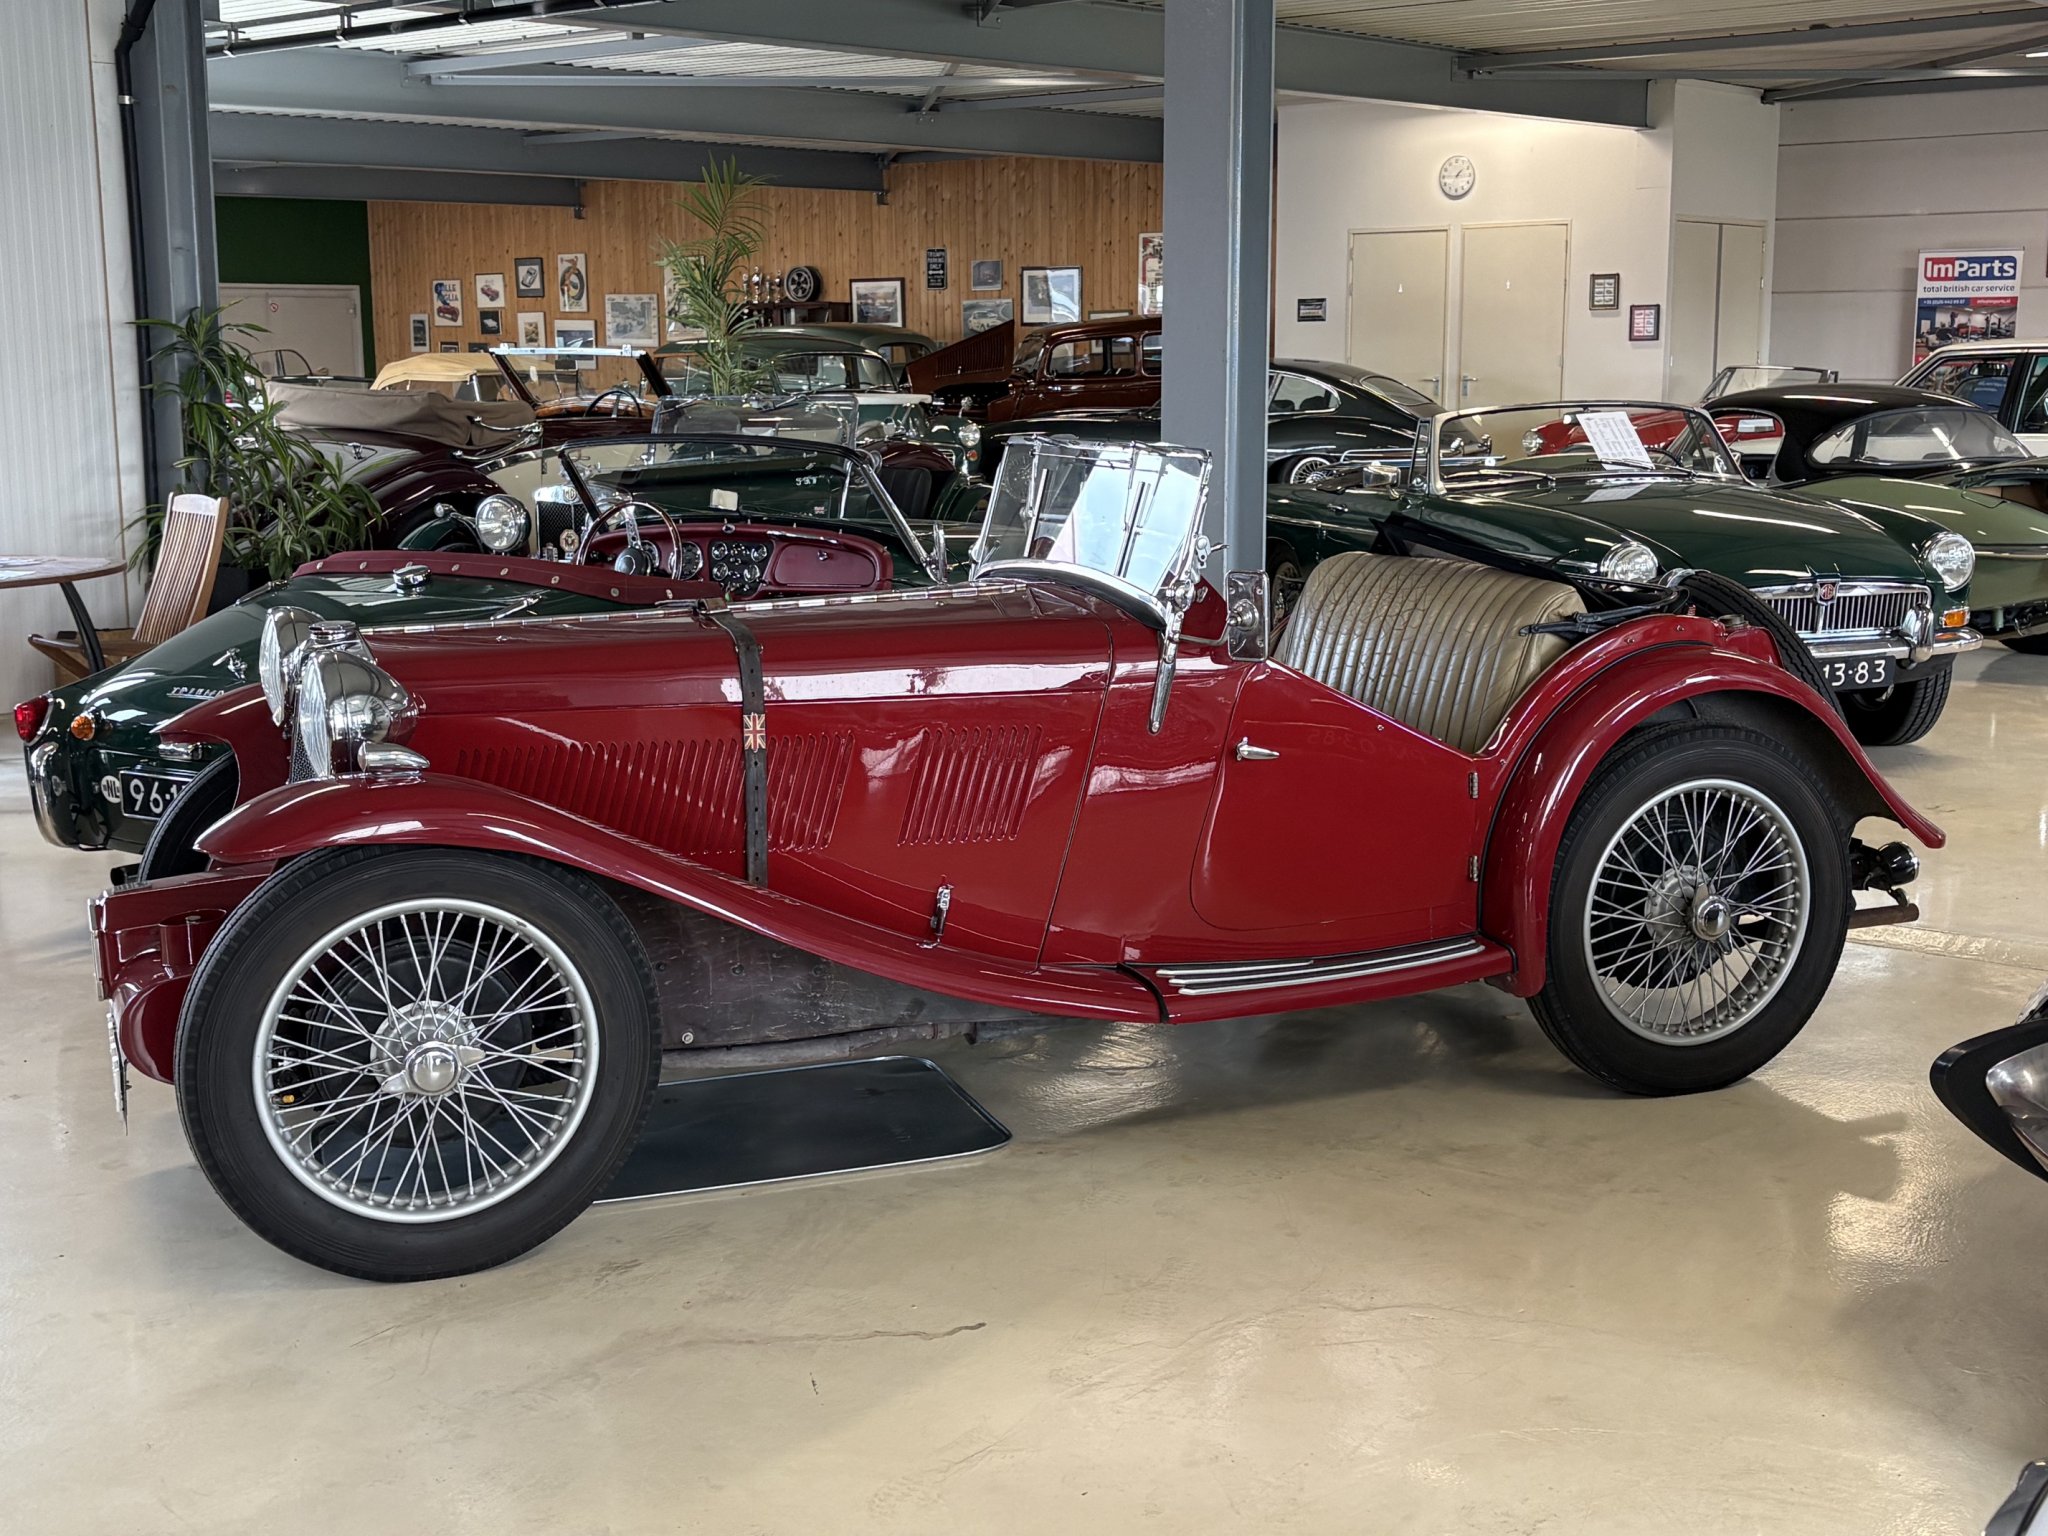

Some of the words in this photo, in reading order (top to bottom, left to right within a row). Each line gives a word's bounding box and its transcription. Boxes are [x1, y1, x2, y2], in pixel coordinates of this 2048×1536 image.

[1926, 260, 2015, 277] ImParts
[1923, 285, 1942, 293] total
[1943, 284, 1970, 292] british
[1985, 284, 2015, 292] service
[171, 686, 225, 698] TRIUMP
[106, 780, 119, 799] NL
